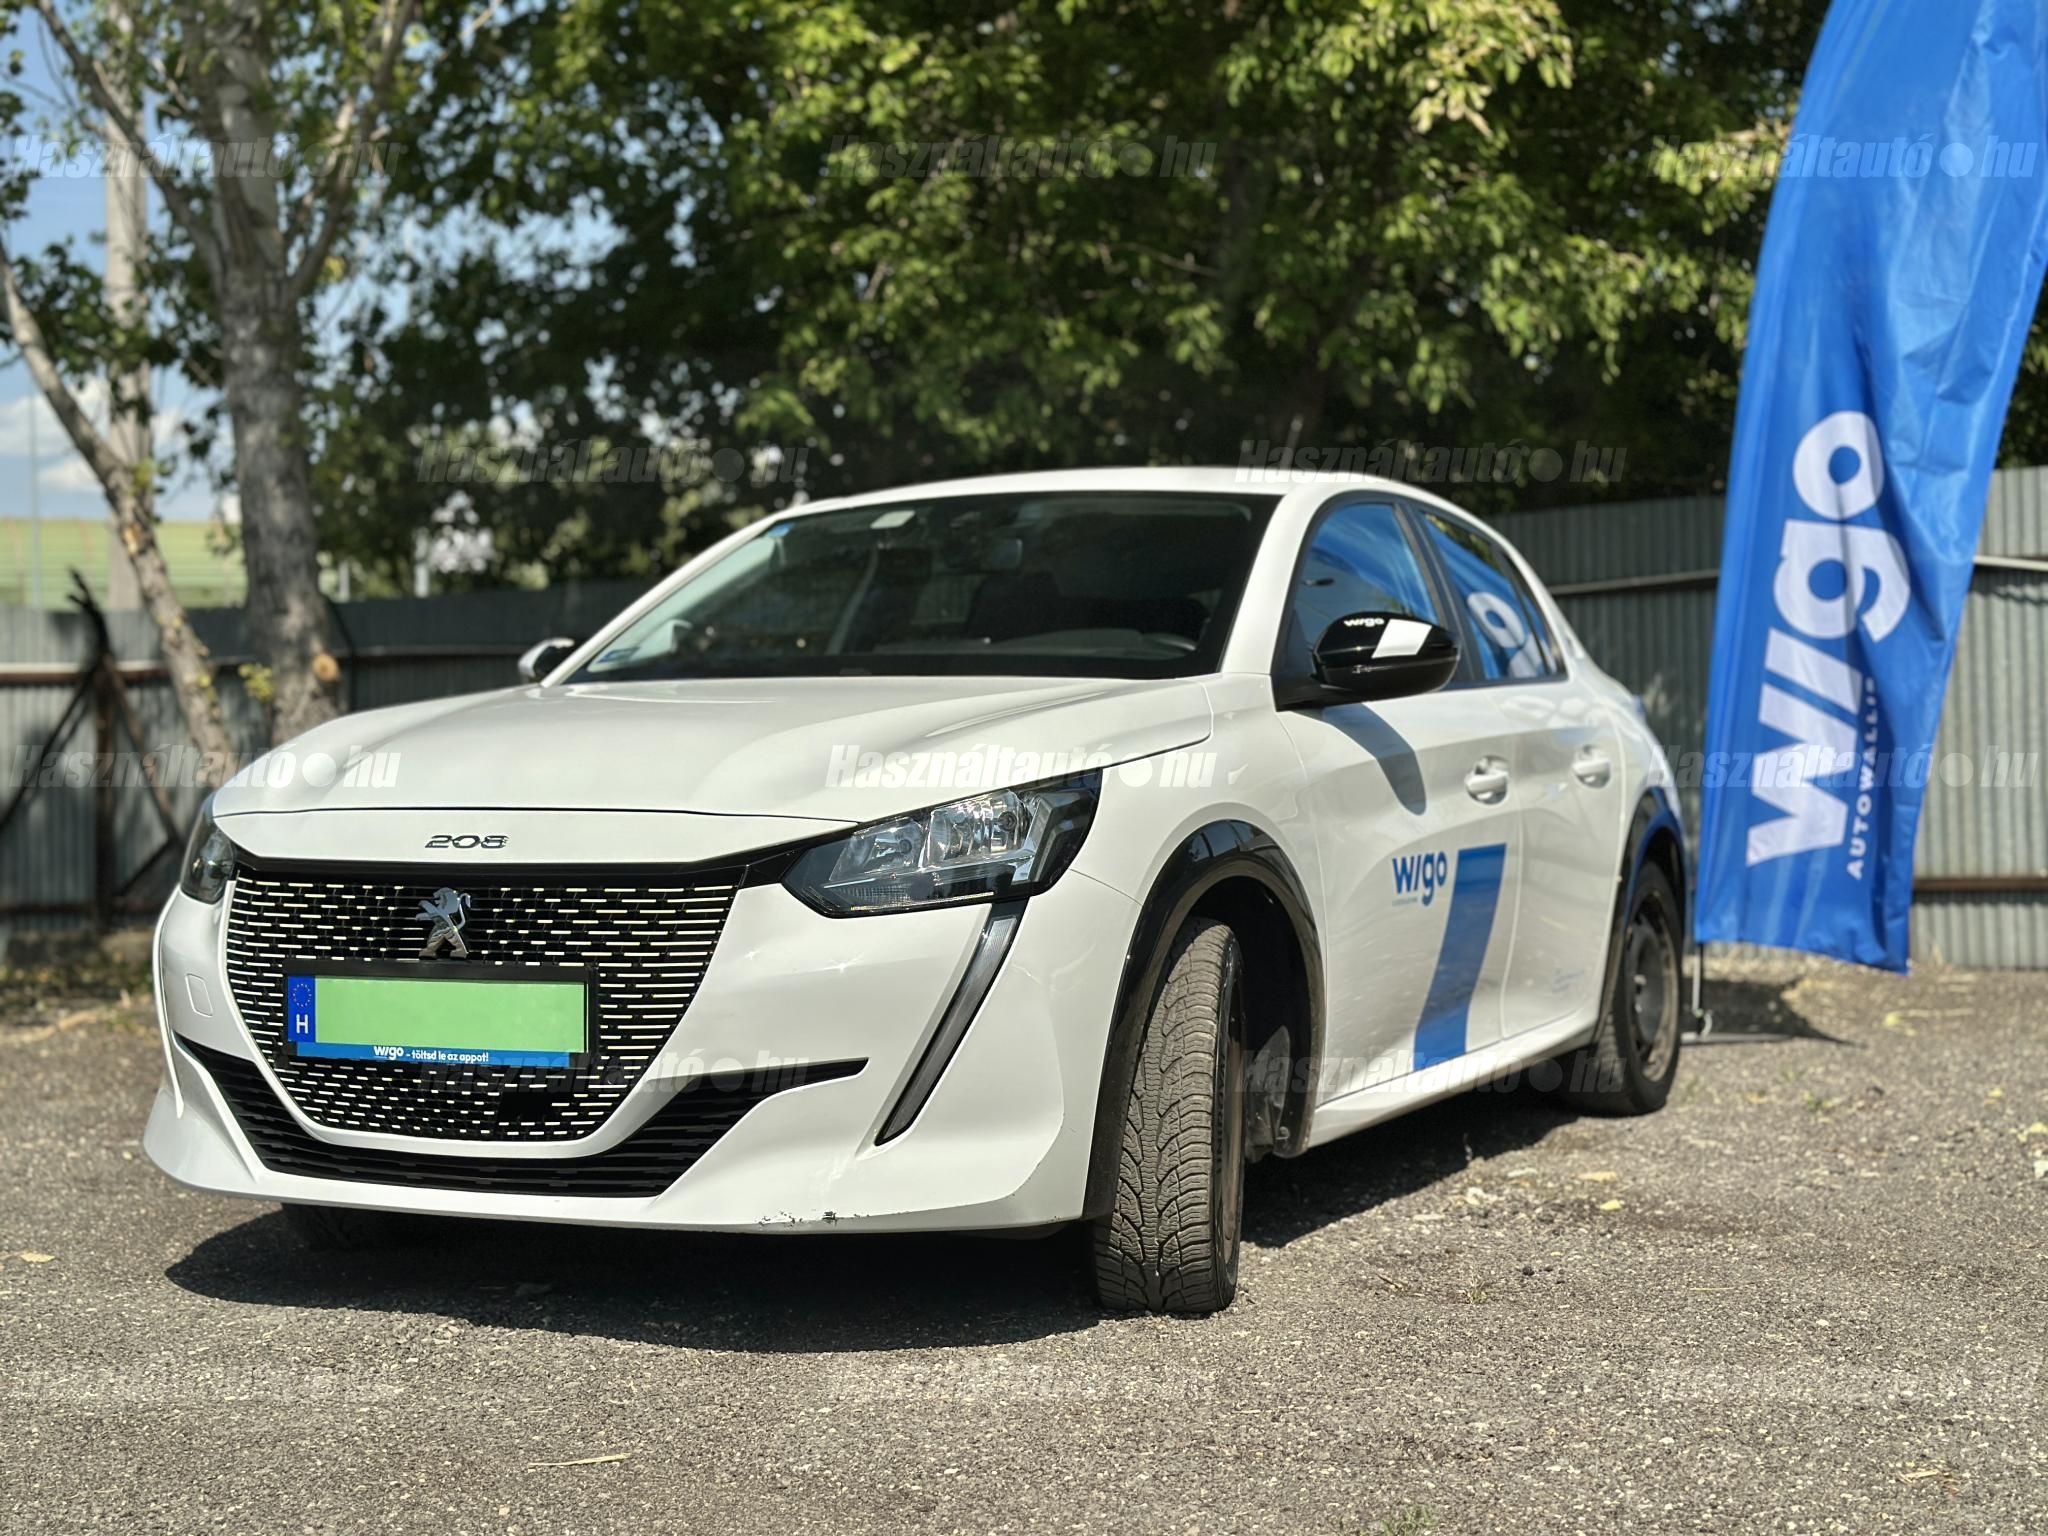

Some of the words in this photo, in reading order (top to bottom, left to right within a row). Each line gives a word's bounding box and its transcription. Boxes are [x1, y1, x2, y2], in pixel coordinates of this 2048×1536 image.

[424, 834, 509, 849] 208
[296, 1014, 309, 1034] H
[438, 1051, 446, 1061] le
[447, 1053, 458, 1061] az
[459, 1053, 489, 1064] appot!
